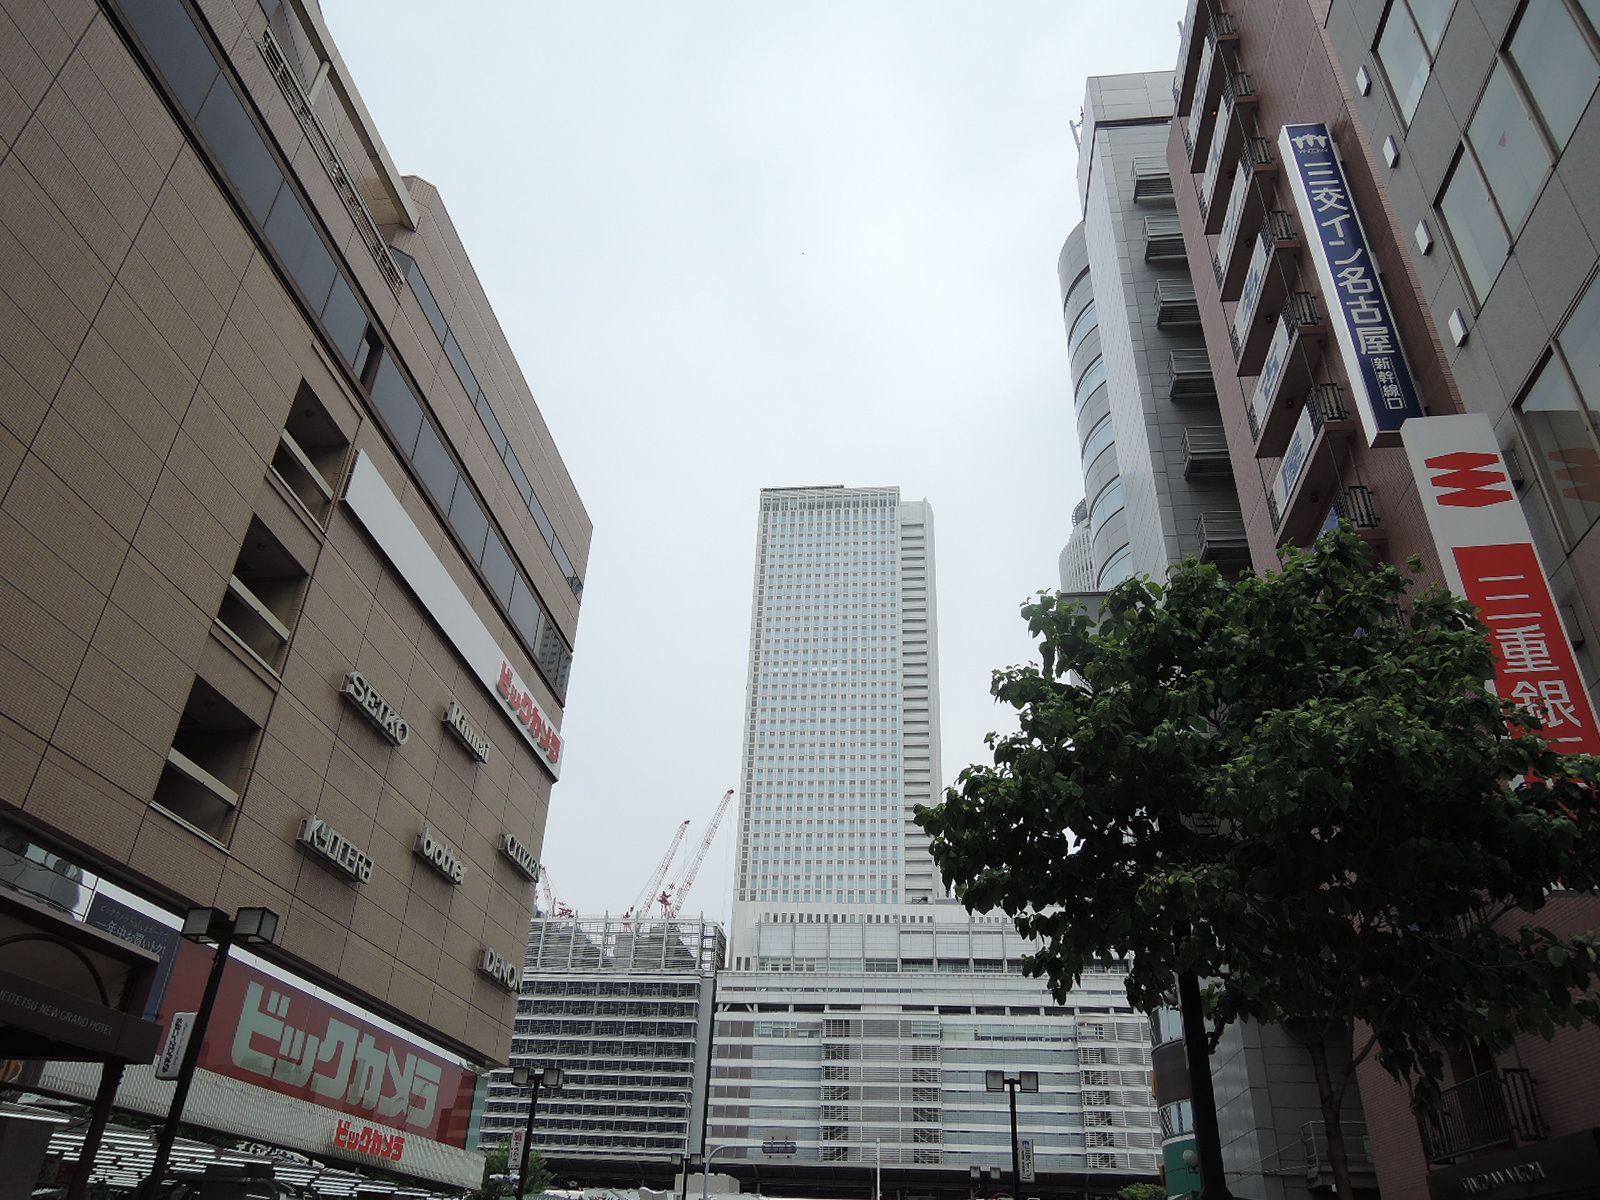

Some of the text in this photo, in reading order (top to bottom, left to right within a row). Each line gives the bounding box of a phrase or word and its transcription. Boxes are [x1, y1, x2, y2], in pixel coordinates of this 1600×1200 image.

[1304, 162, 1395, 355] 三交イン名古屋
[1373, 357, 1404, 410] 新幹線口
[1478, 574, 1583, 742] 三重銀
[346, 671, 409, 745] SEIKO
[450, 702, 489, 764] Rinnai
[496, 660, 561, 764] ビックカメラ
[421, 826, 467, 885] brother
[503, 833, 540, 883] CITIZEN
[484, 947, 522, 994] DENON
[39, 1004, 60, 1018] NEW
[59, 1011, 89, 1027] GRAND
[89, 1020, 113, 1037] HOTEL
[231, 981, 442, 1129] ビックカメラ
[334, 1119, 406, 1162] ビックカメラ
